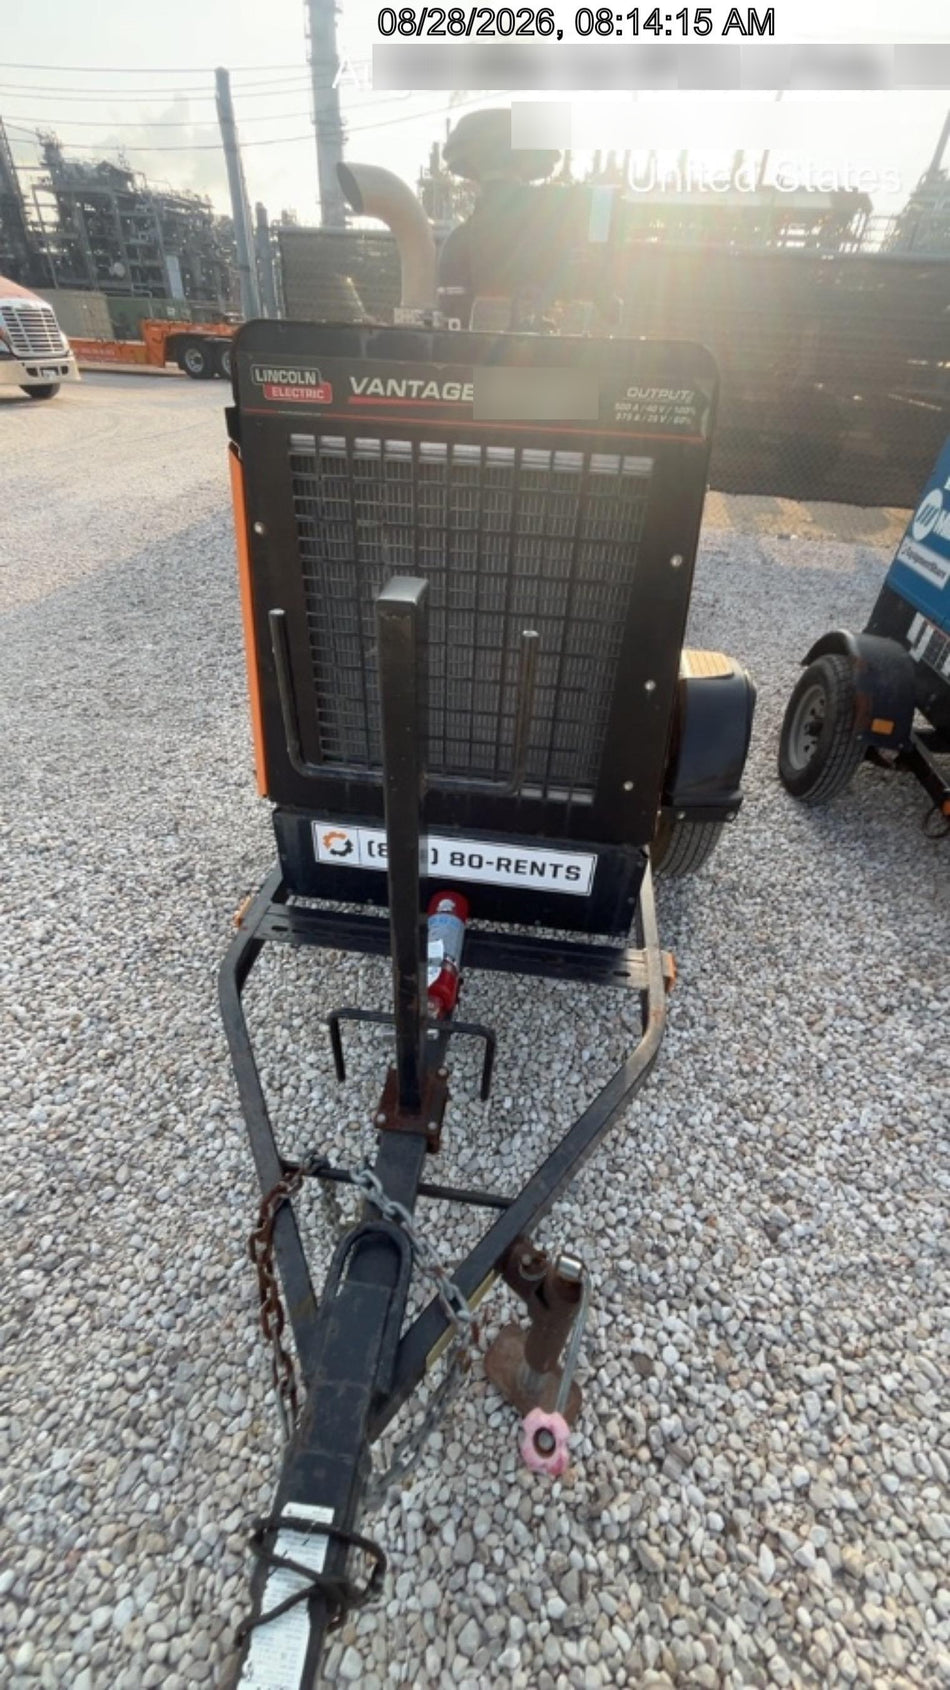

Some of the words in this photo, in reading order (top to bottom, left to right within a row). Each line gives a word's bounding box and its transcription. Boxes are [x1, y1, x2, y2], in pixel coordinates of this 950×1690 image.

[255, 368, 317, 385] LINCOLN
[271, 387, 324, 400] ELECTRIC
[349, 376, 474, 401] VANTAGE
[450, 852, 582, 882] 80-RENTS
